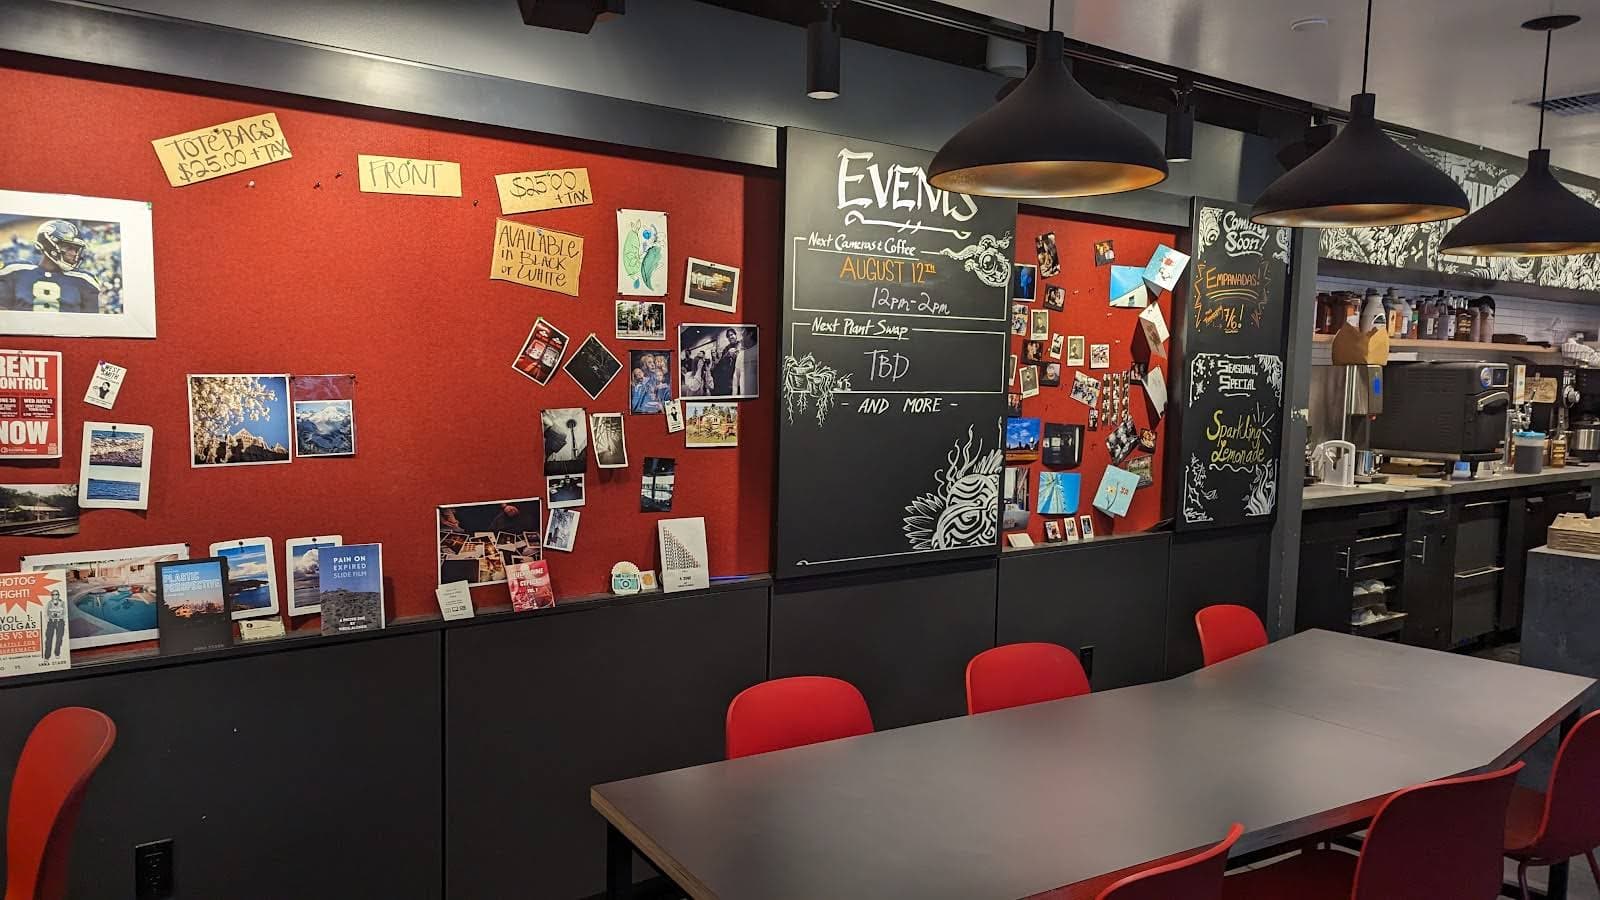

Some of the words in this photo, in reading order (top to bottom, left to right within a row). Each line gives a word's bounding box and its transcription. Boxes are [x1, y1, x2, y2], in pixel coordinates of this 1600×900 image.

[222, 120, 274, 149] BAGS
[178, 150, 246, 182] $25.00
[370, 160, 442, 188] FRONT
[808, 232, 833, 248] Next
[835, 234, 876, 251] Cameras
[884, 238, 916, 256] Coffee
[520, 250, 566, 270] BLACK
[840, 256, 904, 284] AUGUST
[32, 280, 60, 312] 8
[812, 316, 840, 332] Next
[844, 318, 874, 336] Plant
[874, 320, 908, 340] Swap
[864, 349, 910, 382] TBD
[1217, 360, 1258, 374] SEASONAL
[0, 378, 48, 390] ONTROL
[1218, 375, 1256, 392] SPECIAL
[858, 398, 890, 414] AND
[903, 398, 942, 413] MORE
[1206, 410, 1262, 448] Sparkling
[1211, 440, 1265, 464] Lemonade
[0, 576, 36, 586] HOTOG
[0, 589, 30, 598] FIGHT!
[0, 622, 36, 631] OLGAS
[13, 632, 22, 640] VS
